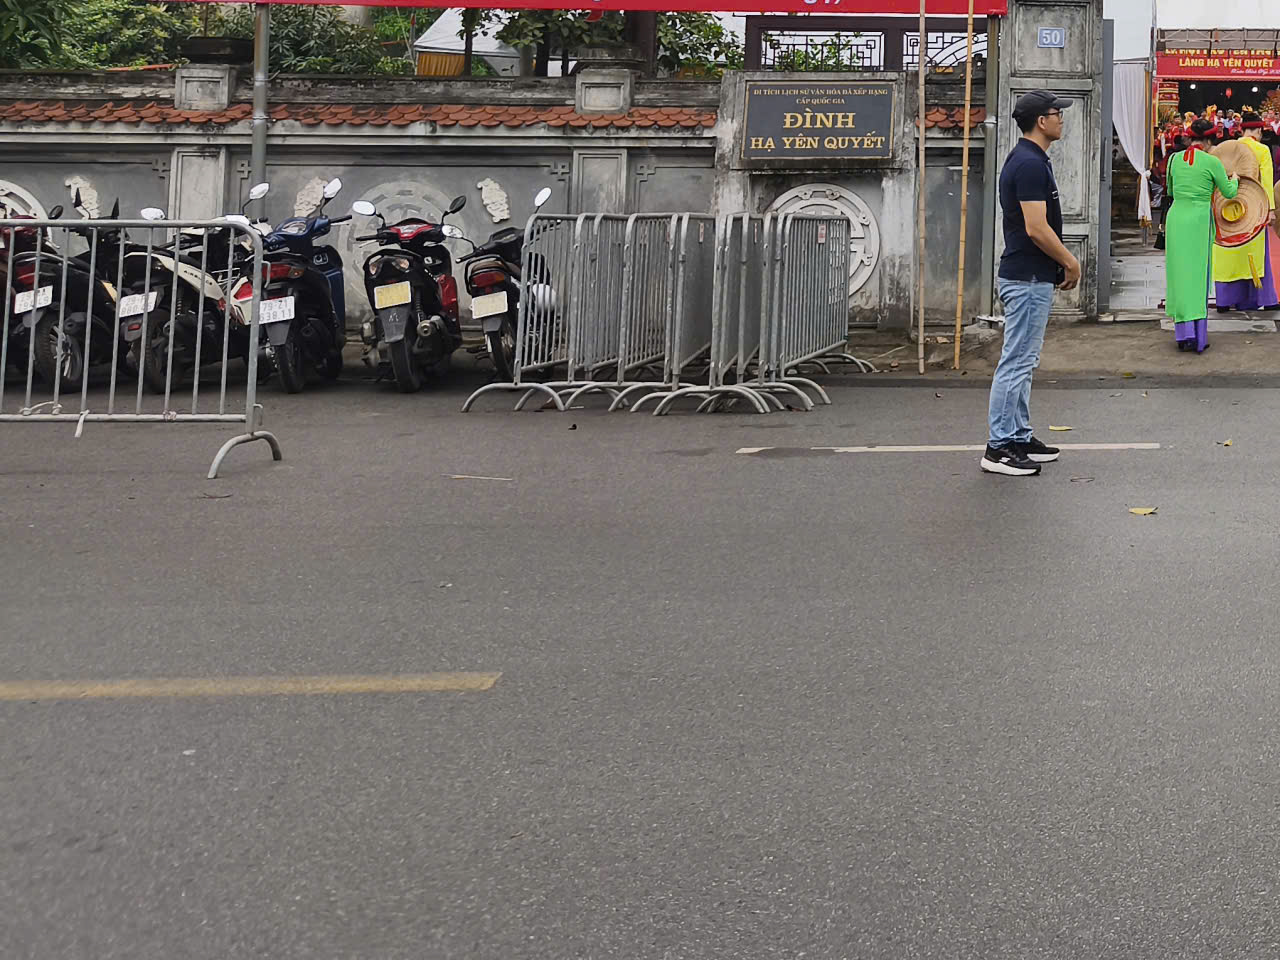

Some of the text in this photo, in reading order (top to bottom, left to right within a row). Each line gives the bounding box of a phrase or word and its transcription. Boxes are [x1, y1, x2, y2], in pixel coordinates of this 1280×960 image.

[1043, 30, 1060, 45] 50
[1179, 57, 1205, 67] LÀNG
[1207, 58, 1221, 68] HẠ
[1223, 57, 1242, 67] YÊN
[783, 107, 856, 129] ĐÌNH
[750, 130, 885, 153] HẠ YÊN QUYẾT
